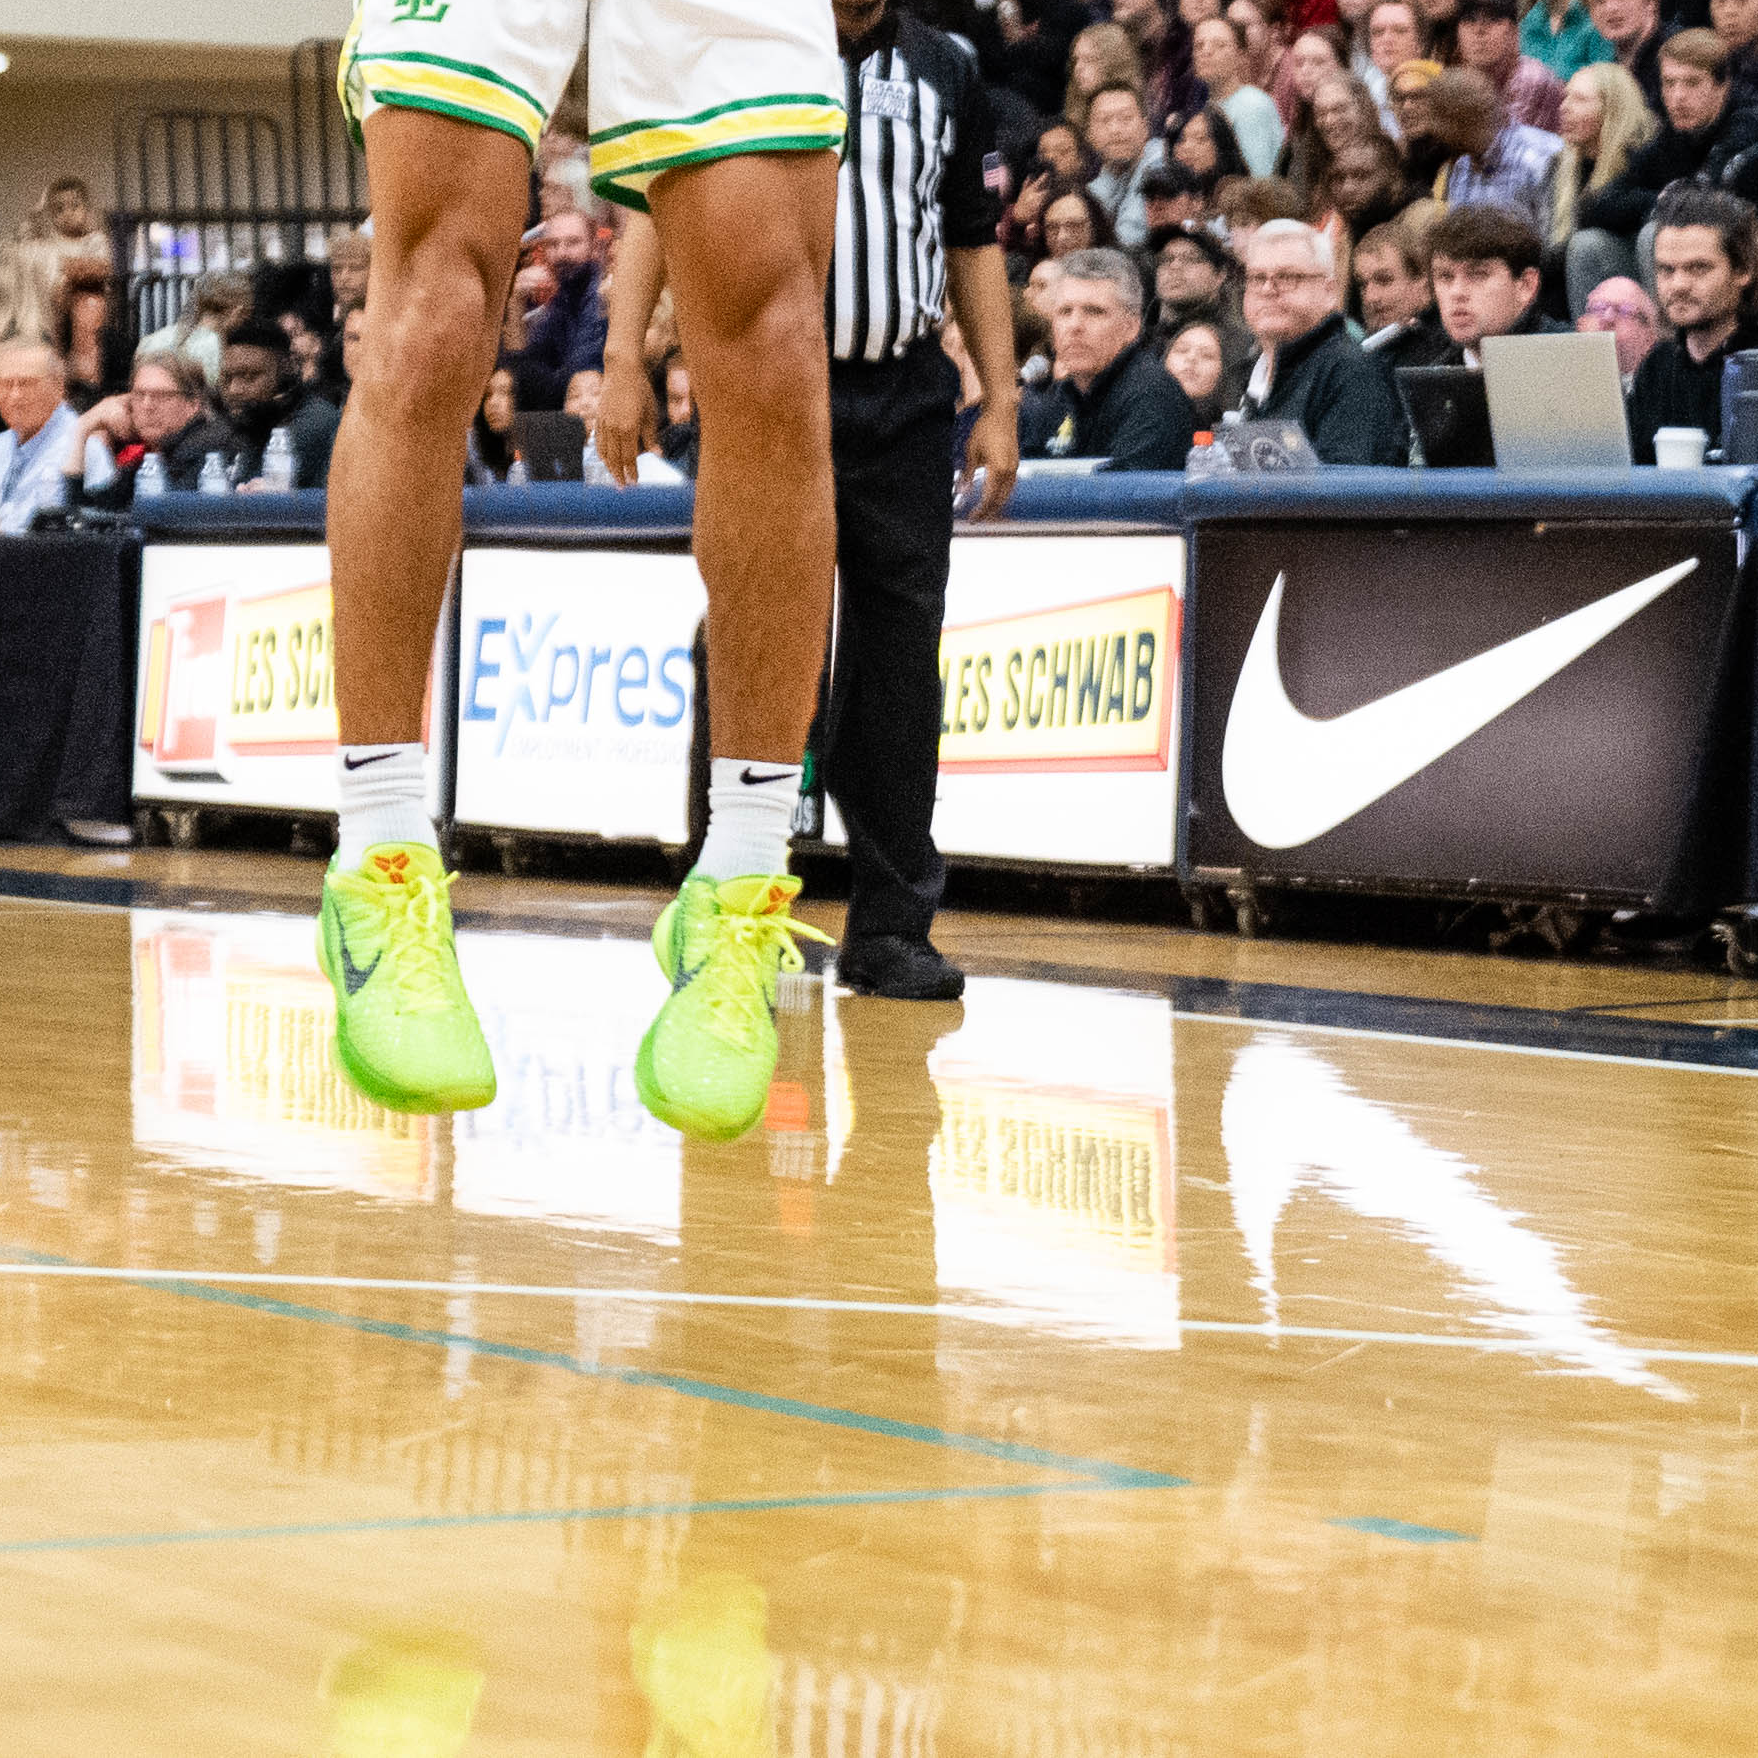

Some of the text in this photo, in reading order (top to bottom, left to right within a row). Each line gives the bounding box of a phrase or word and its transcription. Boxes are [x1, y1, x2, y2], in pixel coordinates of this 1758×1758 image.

[231, 625, 277, 715] LES
[939, 627, 1156, 734] LES SCHWAB
